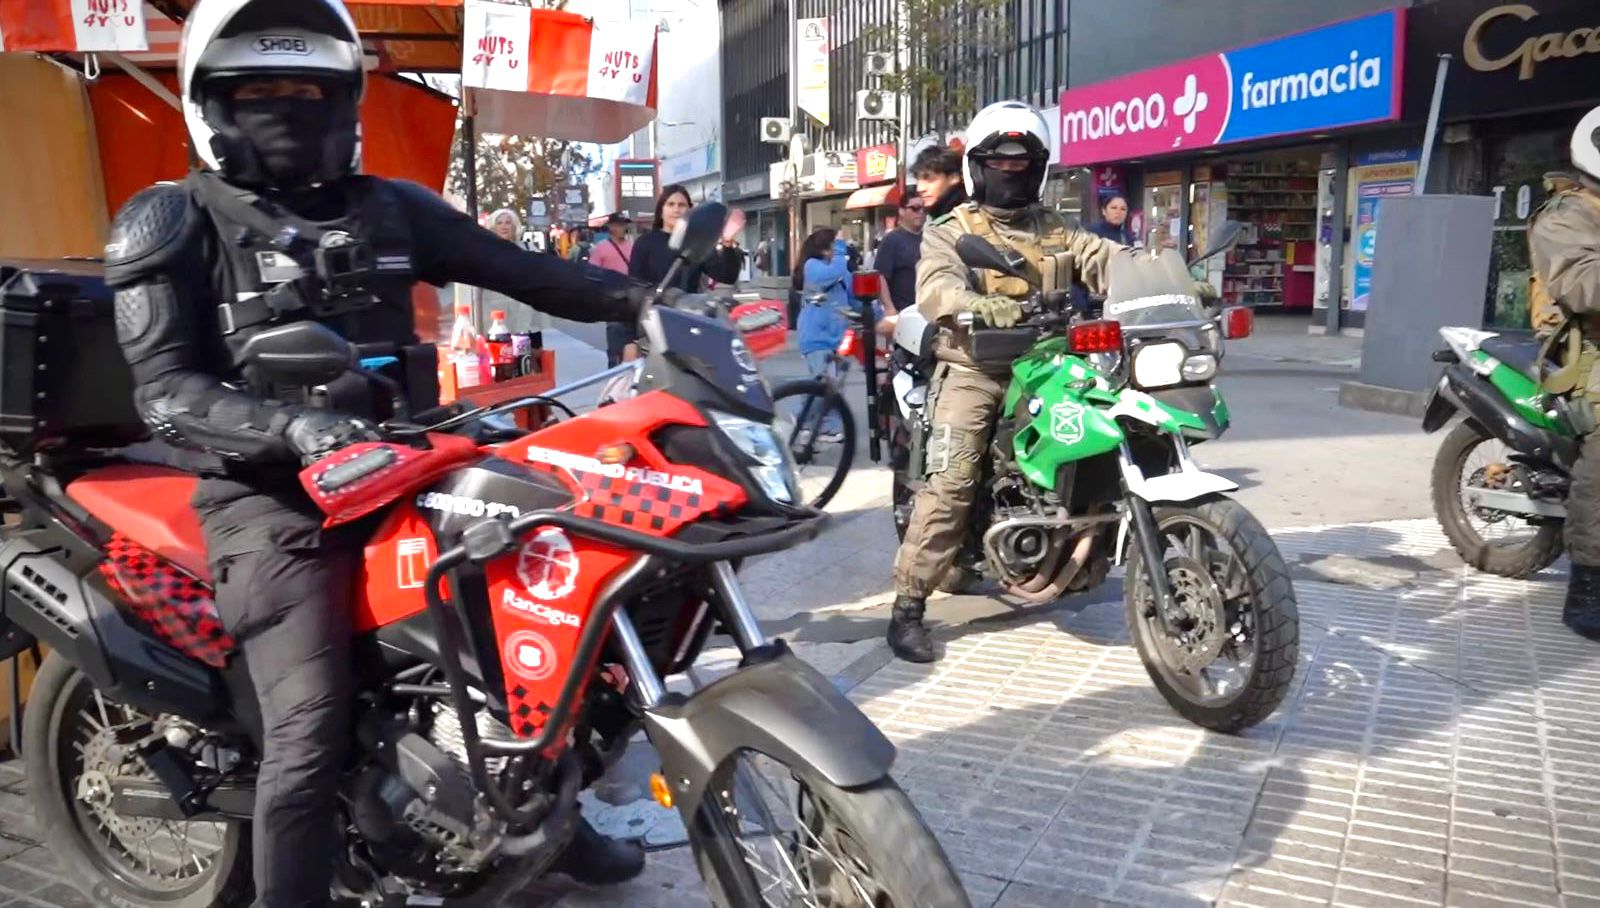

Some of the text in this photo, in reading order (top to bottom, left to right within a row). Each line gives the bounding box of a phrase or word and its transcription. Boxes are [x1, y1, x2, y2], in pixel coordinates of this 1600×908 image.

[259, 38, 307, 52] SHOEI
[478, 36, 514, 54] NUTS
[605, 51, 639, 68] NUTS
[1062, 50, 1381, 144] maicao farmacia
[503, 589, 580, 627] Rancagua
